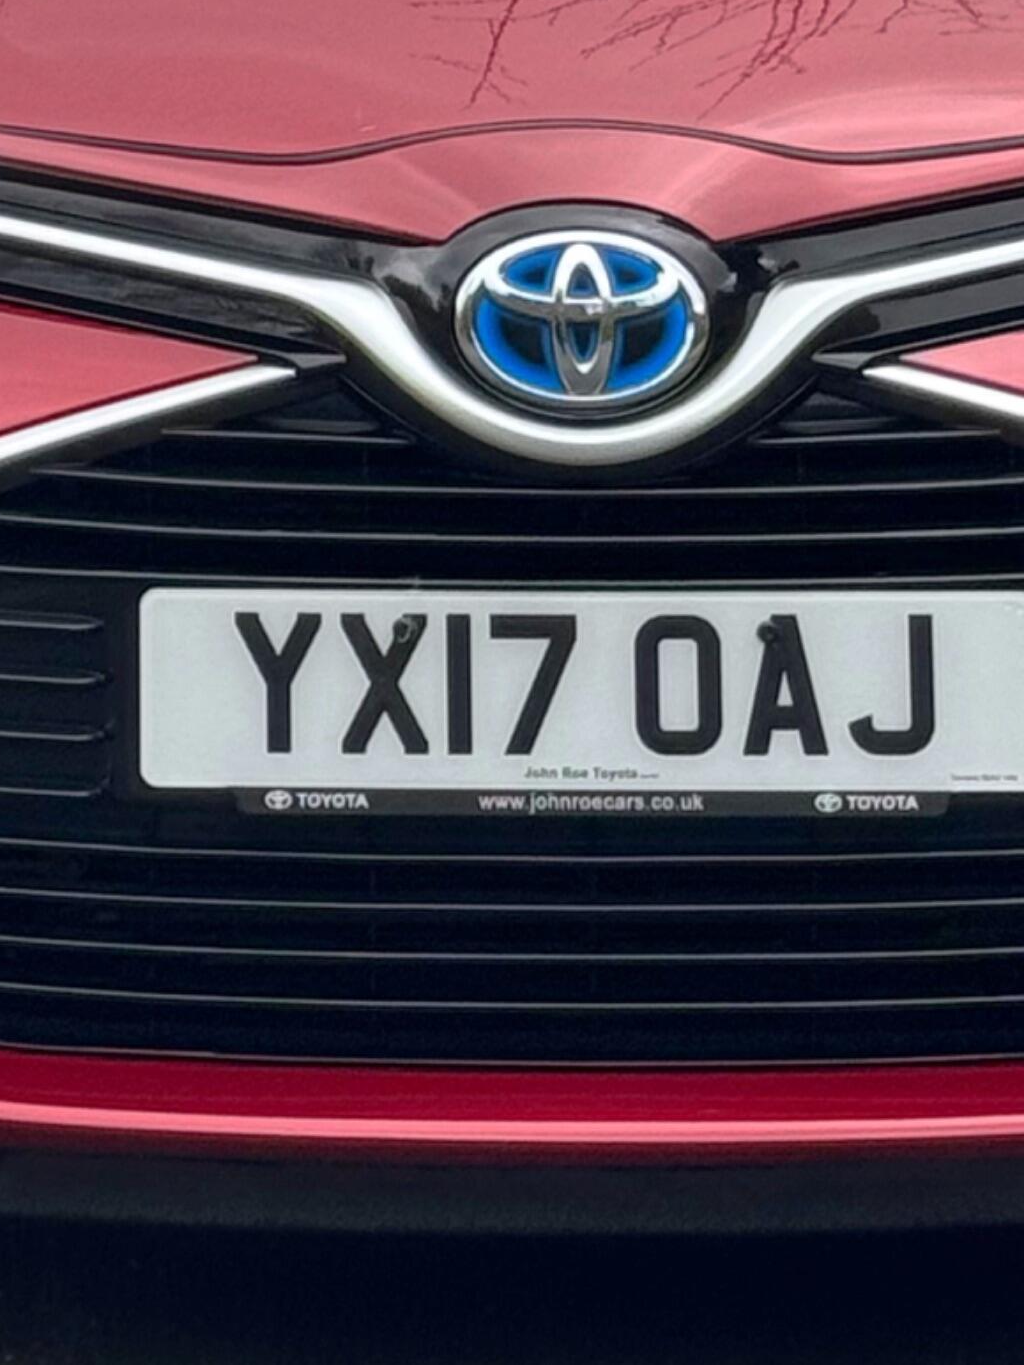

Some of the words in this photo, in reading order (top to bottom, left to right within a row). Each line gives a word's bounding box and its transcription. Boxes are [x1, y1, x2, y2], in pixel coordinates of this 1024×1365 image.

[234, 612, 577, 756] YX17
[634, 614, 936, 756] OAJ
[524, 766, 558, 779] John
[593, 766, 638, 782] Toyota
[296, 792, 370, 810] TOYOTA
[478, 792, 705, 815] www.johnroecars.co.uk
[846, 794, 920, 811] TOYOTA
